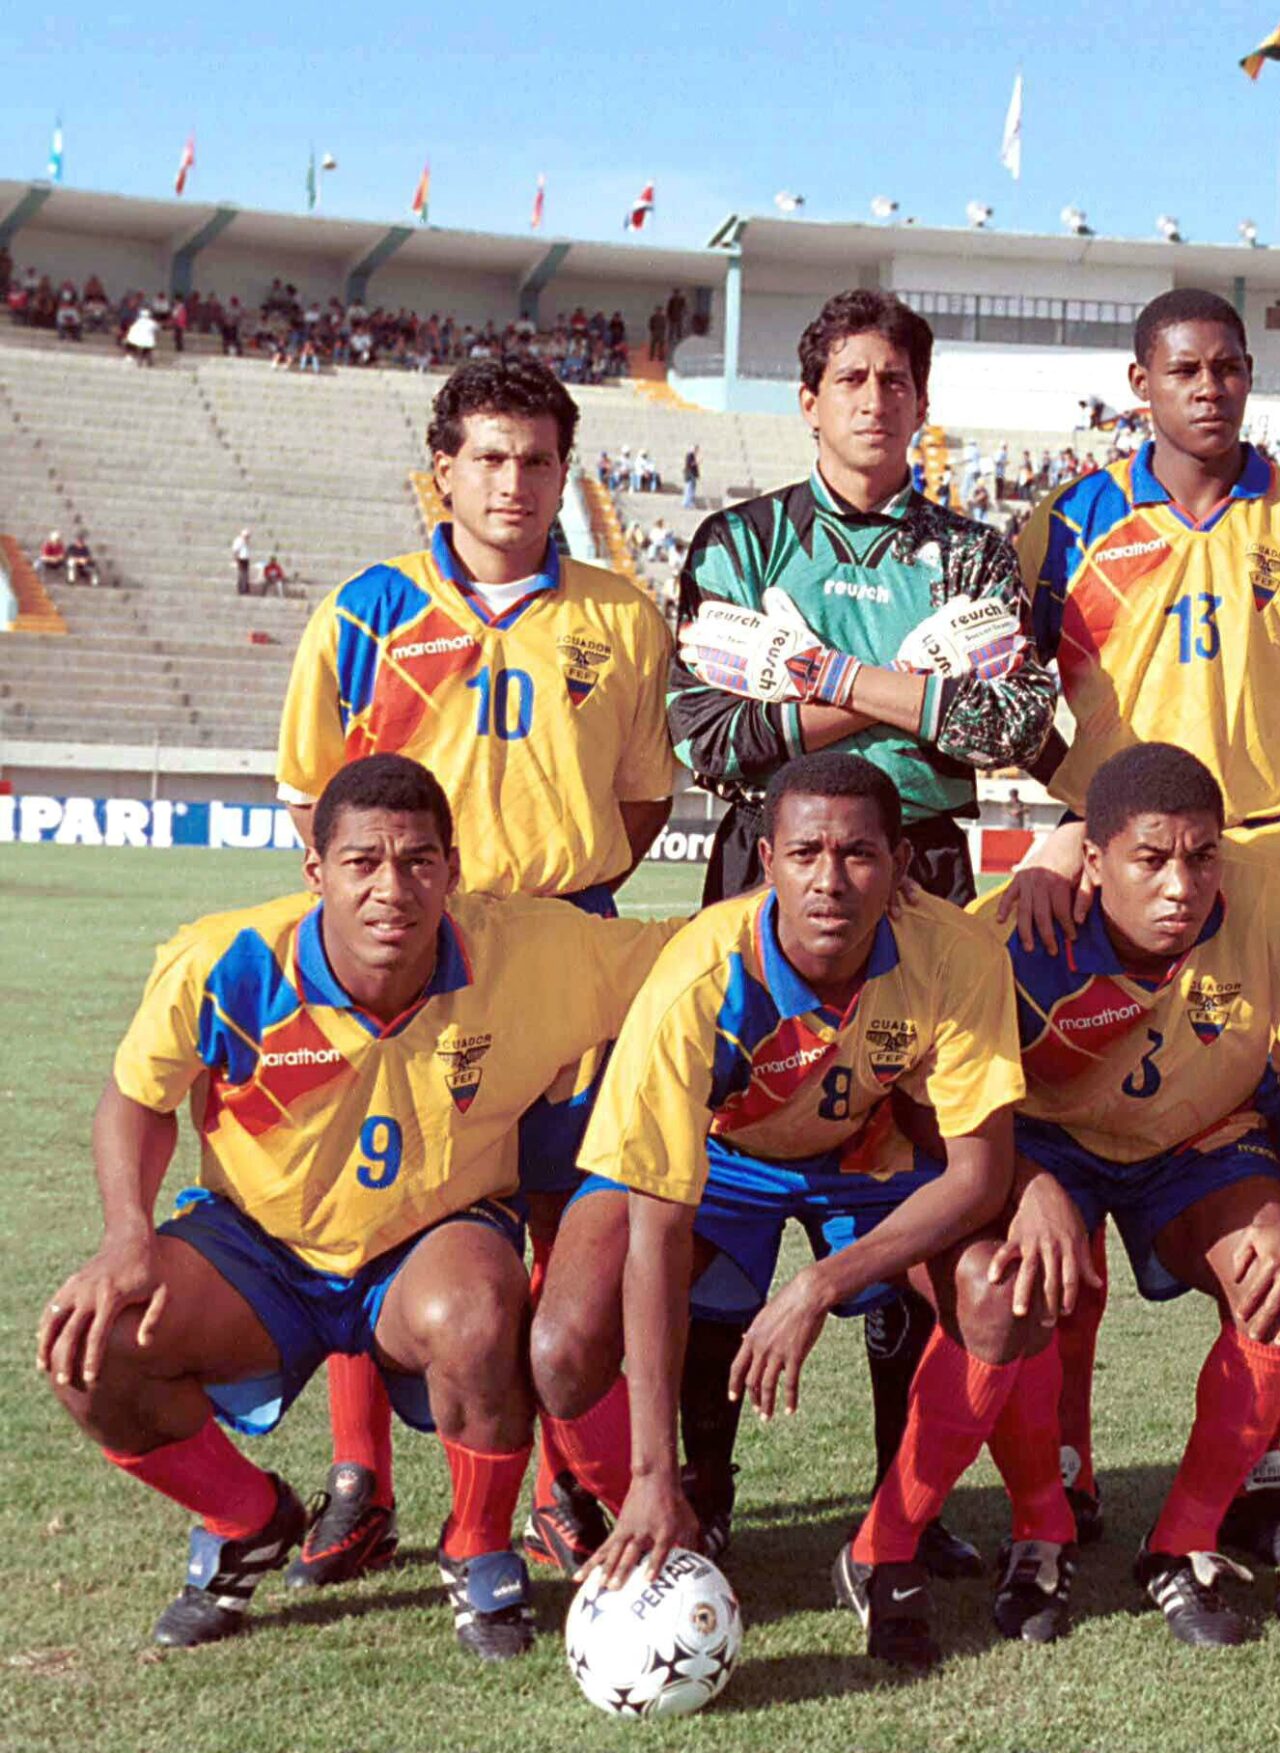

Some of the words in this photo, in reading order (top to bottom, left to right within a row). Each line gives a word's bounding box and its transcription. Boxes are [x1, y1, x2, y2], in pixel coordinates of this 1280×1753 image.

[1095, 539, 1167, 562] marathon
[823, 579, 889, 604] reusch
[706, 608, 761, 629] reusch
[949, 603, 1002, 629] reusch
[1164, 592, 1222, 664] 13
[391, 634, 475, 661] marathon
[758, 627, 790, 692] reusch
[465, 665, 535, 741] 10
[1059, 1003, 1141, 1031] marathon
[1122, 1028, 1164, 1098] 3
[453, 1071, 474, 1085] FEF
[818, 1065, 852, 1121] 8
[356, 1115, 403, 1189] 9
